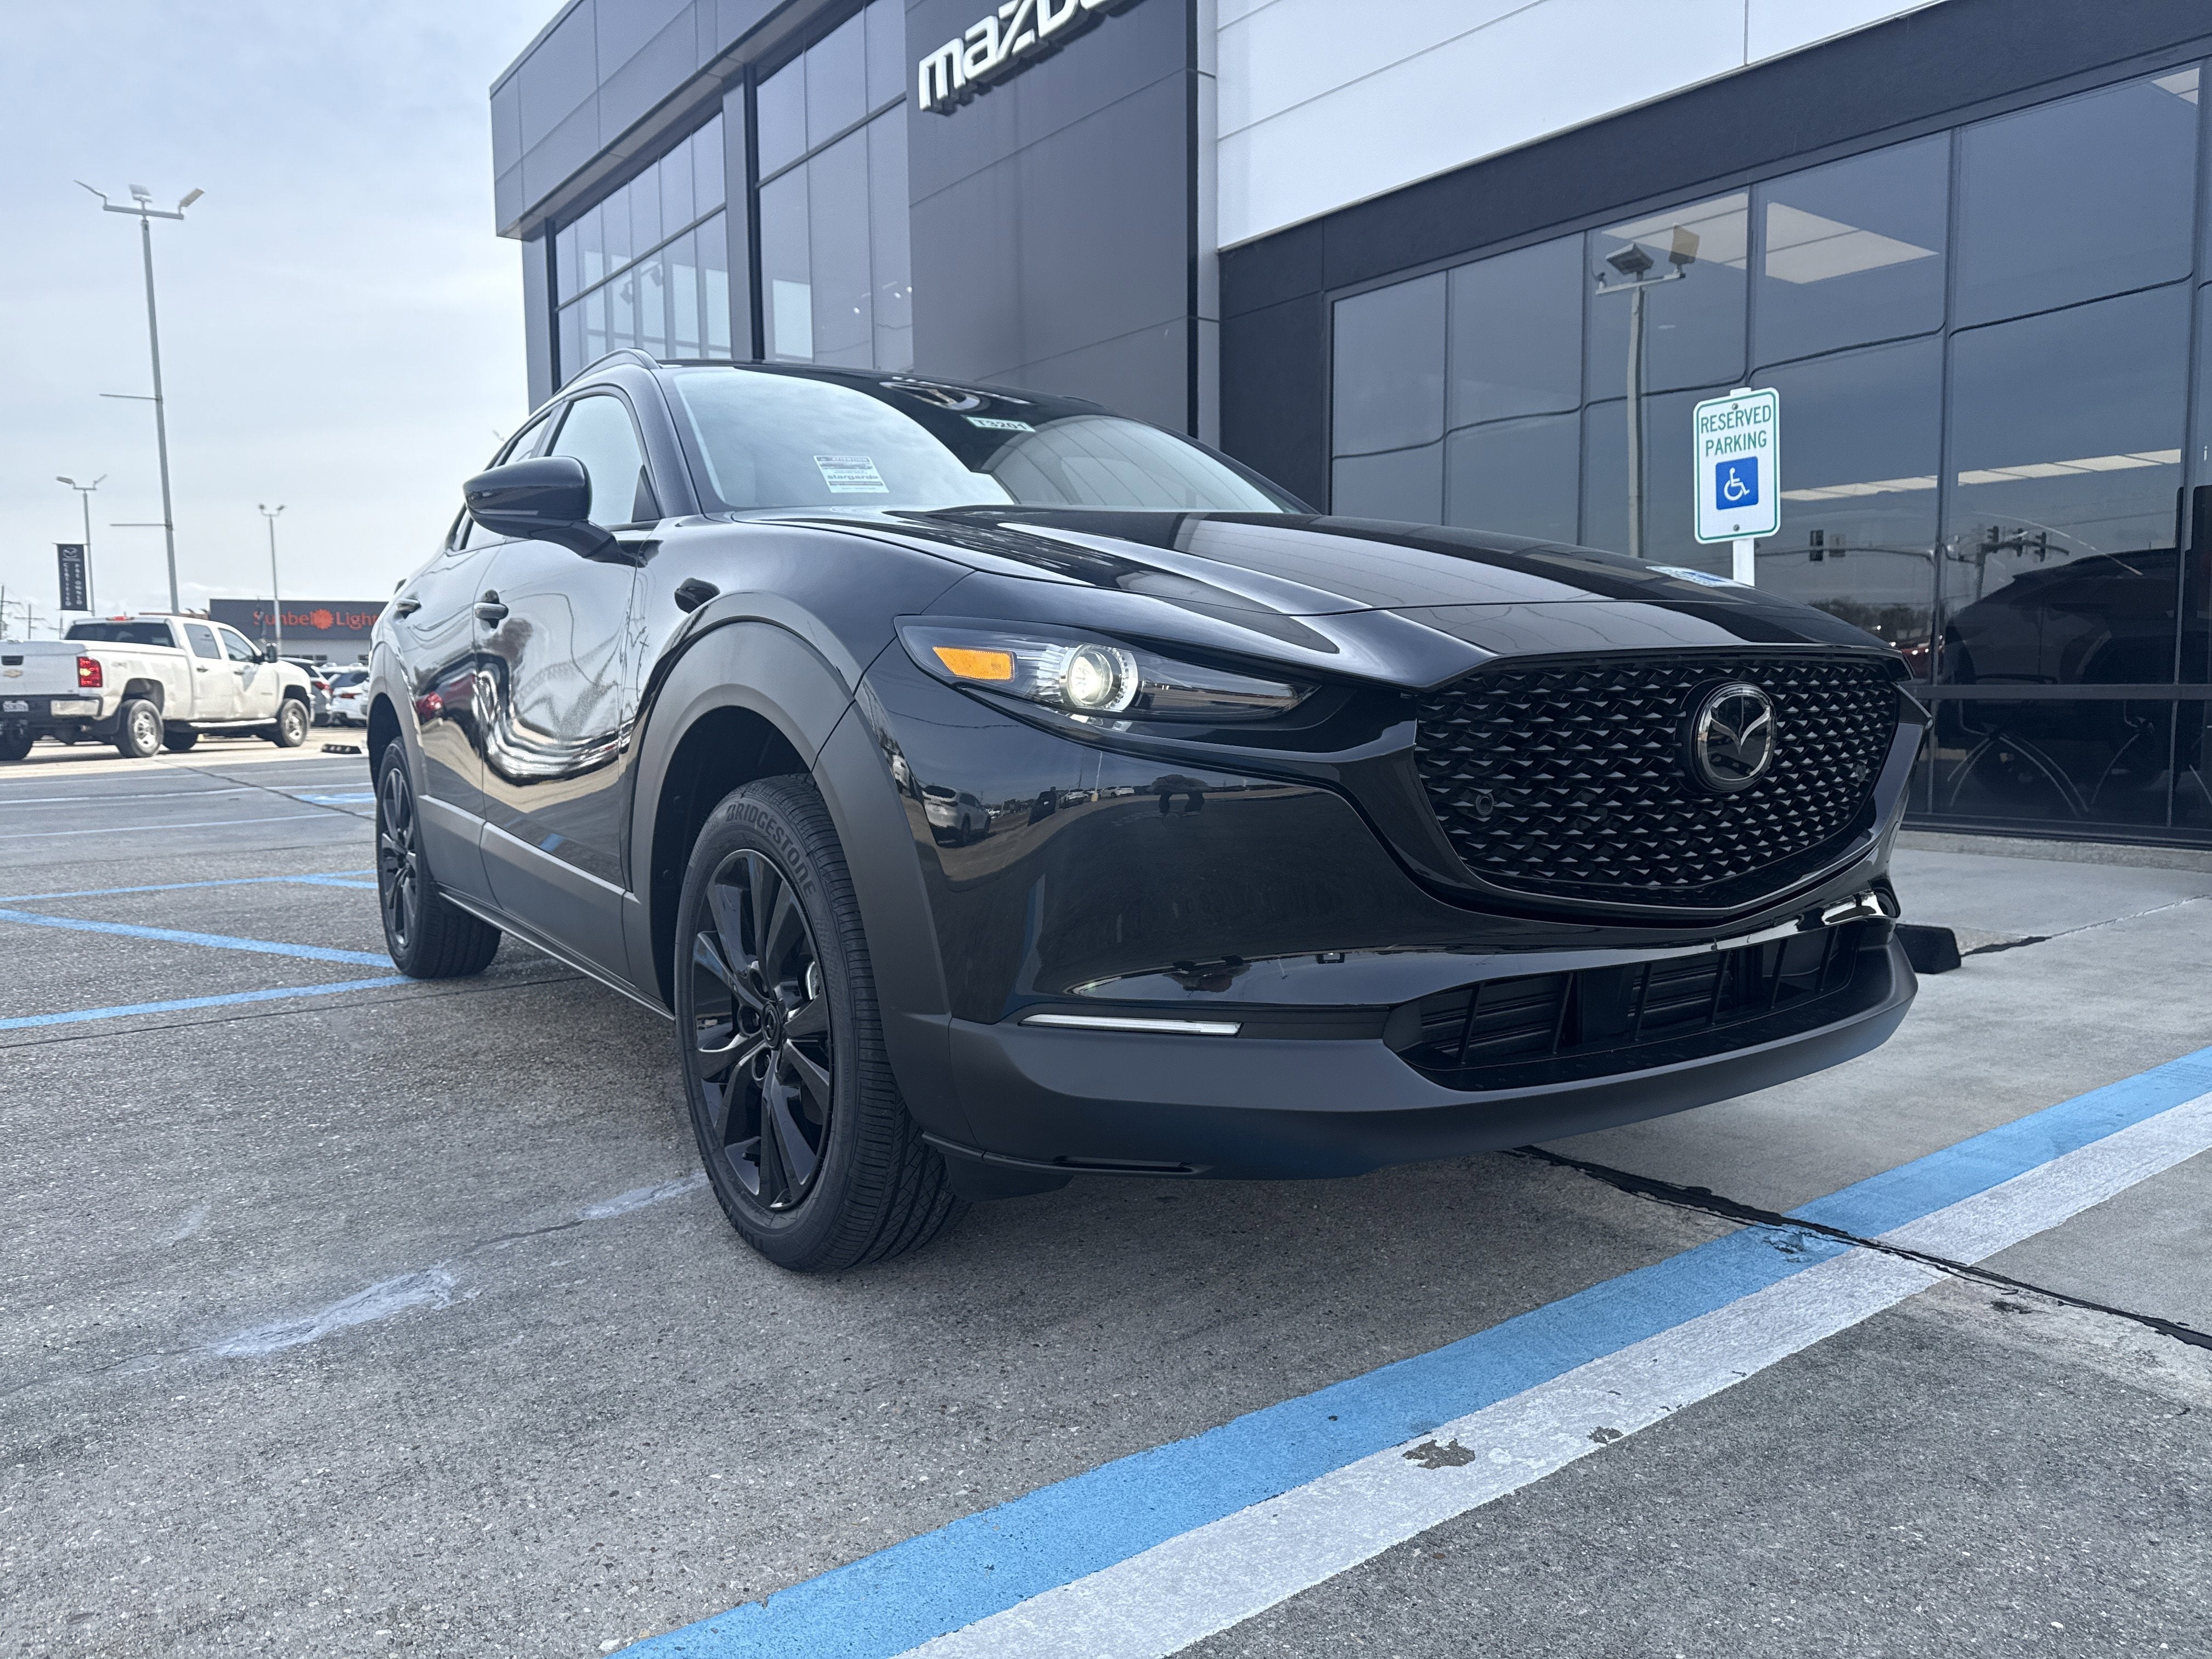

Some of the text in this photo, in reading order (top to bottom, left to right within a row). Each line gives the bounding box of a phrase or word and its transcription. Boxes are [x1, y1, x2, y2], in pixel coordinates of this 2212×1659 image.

[918, 0, 1104, 111] mazd
[1701, 404, 1771, 434] RESERVED
[1706, 430, 1767, 457] PARKING
[725, 802, 817, 899] BRIDGESTONE
